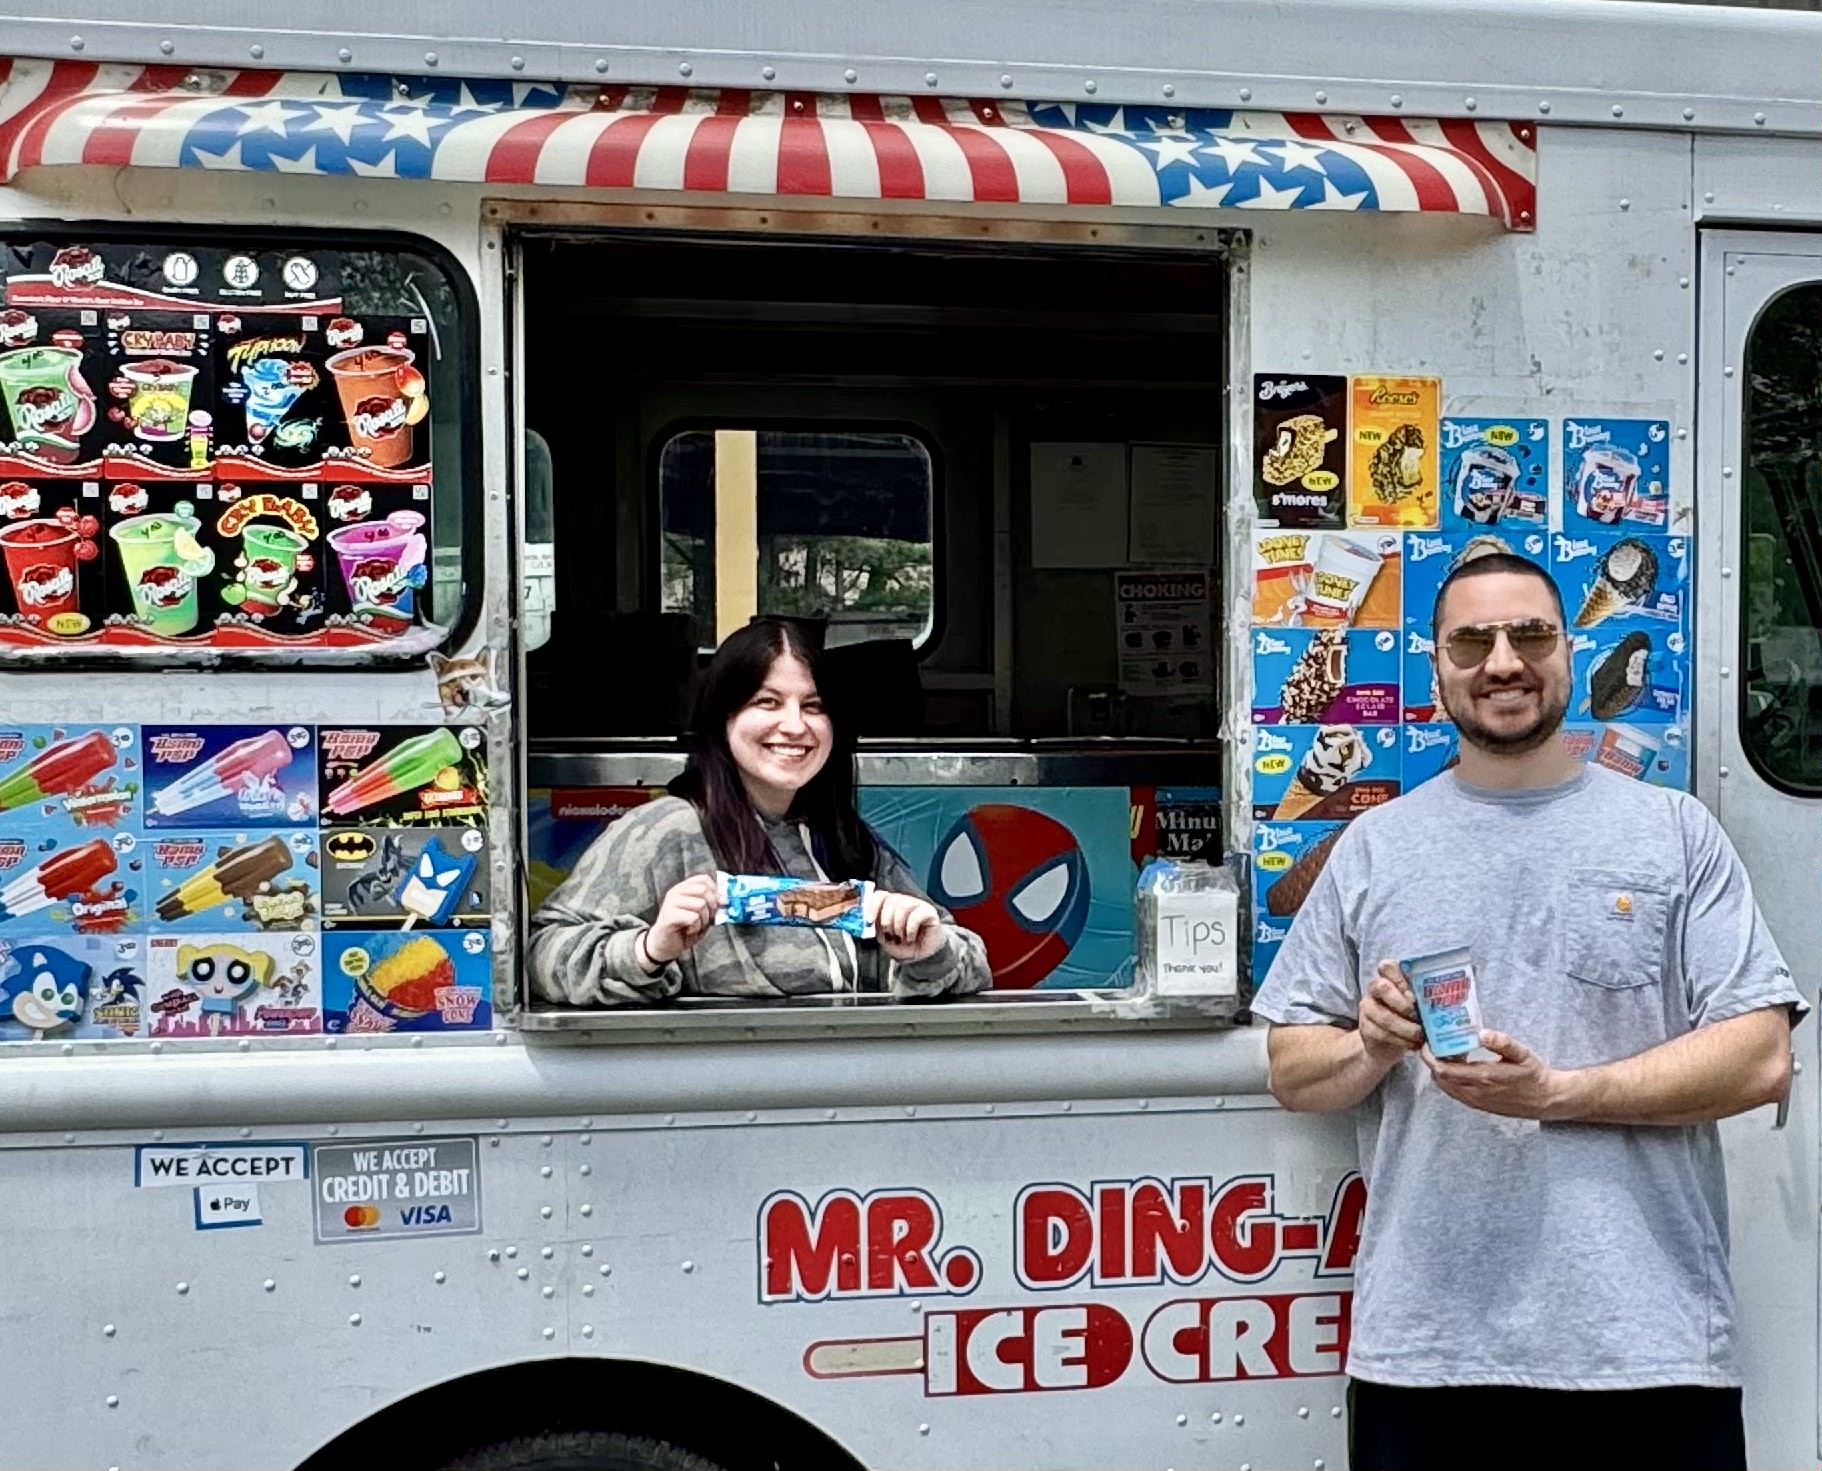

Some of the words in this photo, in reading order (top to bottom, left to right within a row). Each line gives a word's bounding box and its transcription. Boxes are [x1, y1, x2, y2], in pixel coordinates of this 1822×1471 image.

[1119, 583, 1204, 599] CHOKING
[559, 803, 634, 816] nickelode
[1166, 833, 1212, 852] Ma
[1160, 914, 1225, 955] Tips
[150, 1158, 189, 1176] WE
[196, 1156, 296, 1176] ACCEPT
[353, 1151, 379, 1171] WE
[382, 1148, 436, 1170] ACCEPT
[322, 1173, 390, 1203] CREDIT
[394, 1175, 411, 1199] &
[414, 1169, 469, 1197] DEBIT
[224, 1197, 251, 1212] Pay
[400, 1205, 452, 1226] VISA
[760, 1190, 981, 1299] MR.
